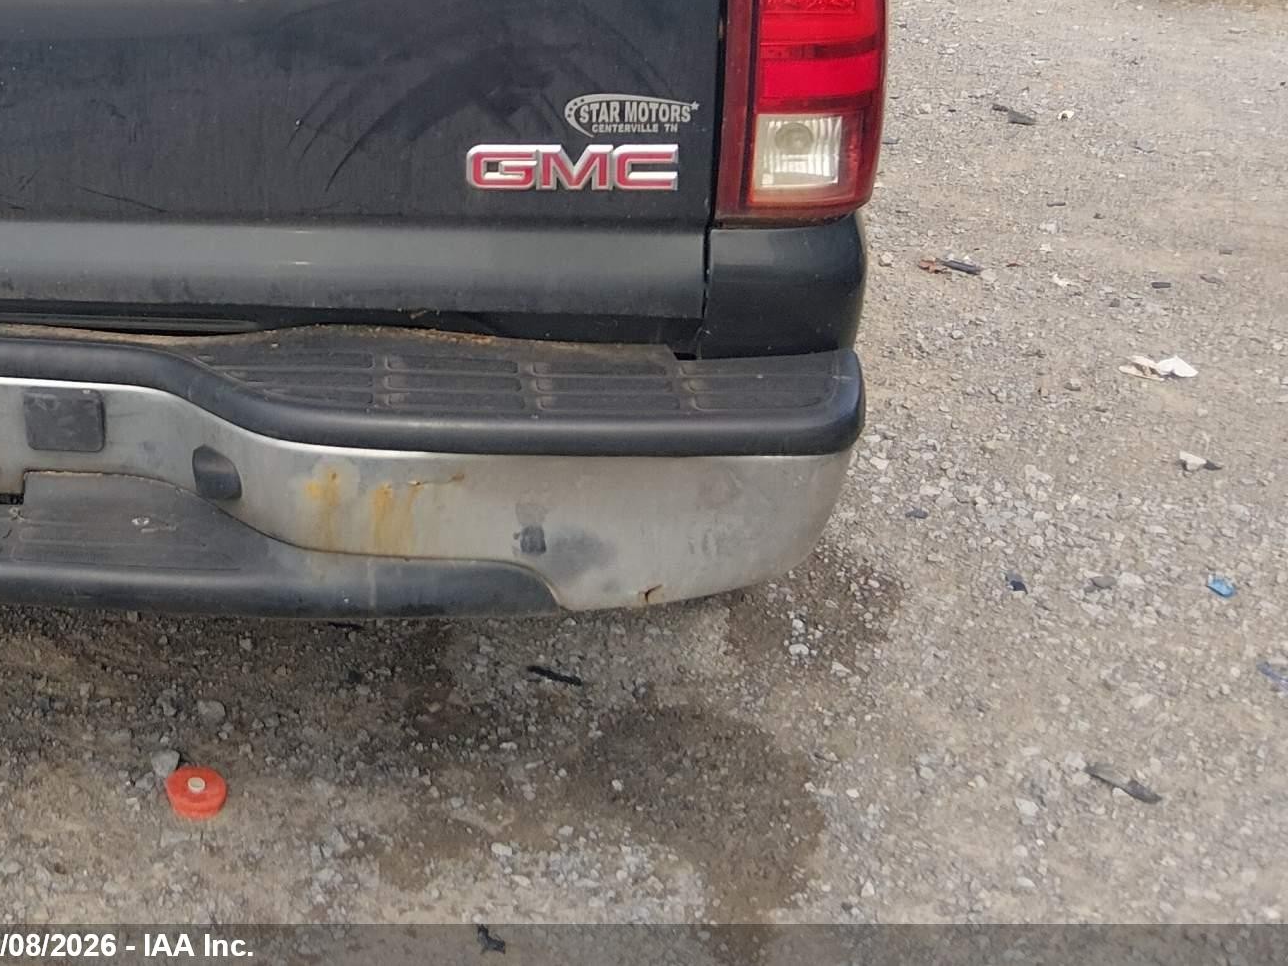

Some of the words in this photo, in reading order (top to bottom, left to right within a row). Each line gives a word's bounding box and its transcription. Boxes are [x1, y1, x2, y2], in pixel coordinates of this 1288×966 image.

[579, 102, 620, 123] STAR
[624, 101, 691, 123] MOTORS
[592, 123, 659, 133] CENTERVILLE
[664, 123, 678, 133] TN
[466, 144, 678, 191] GMC
